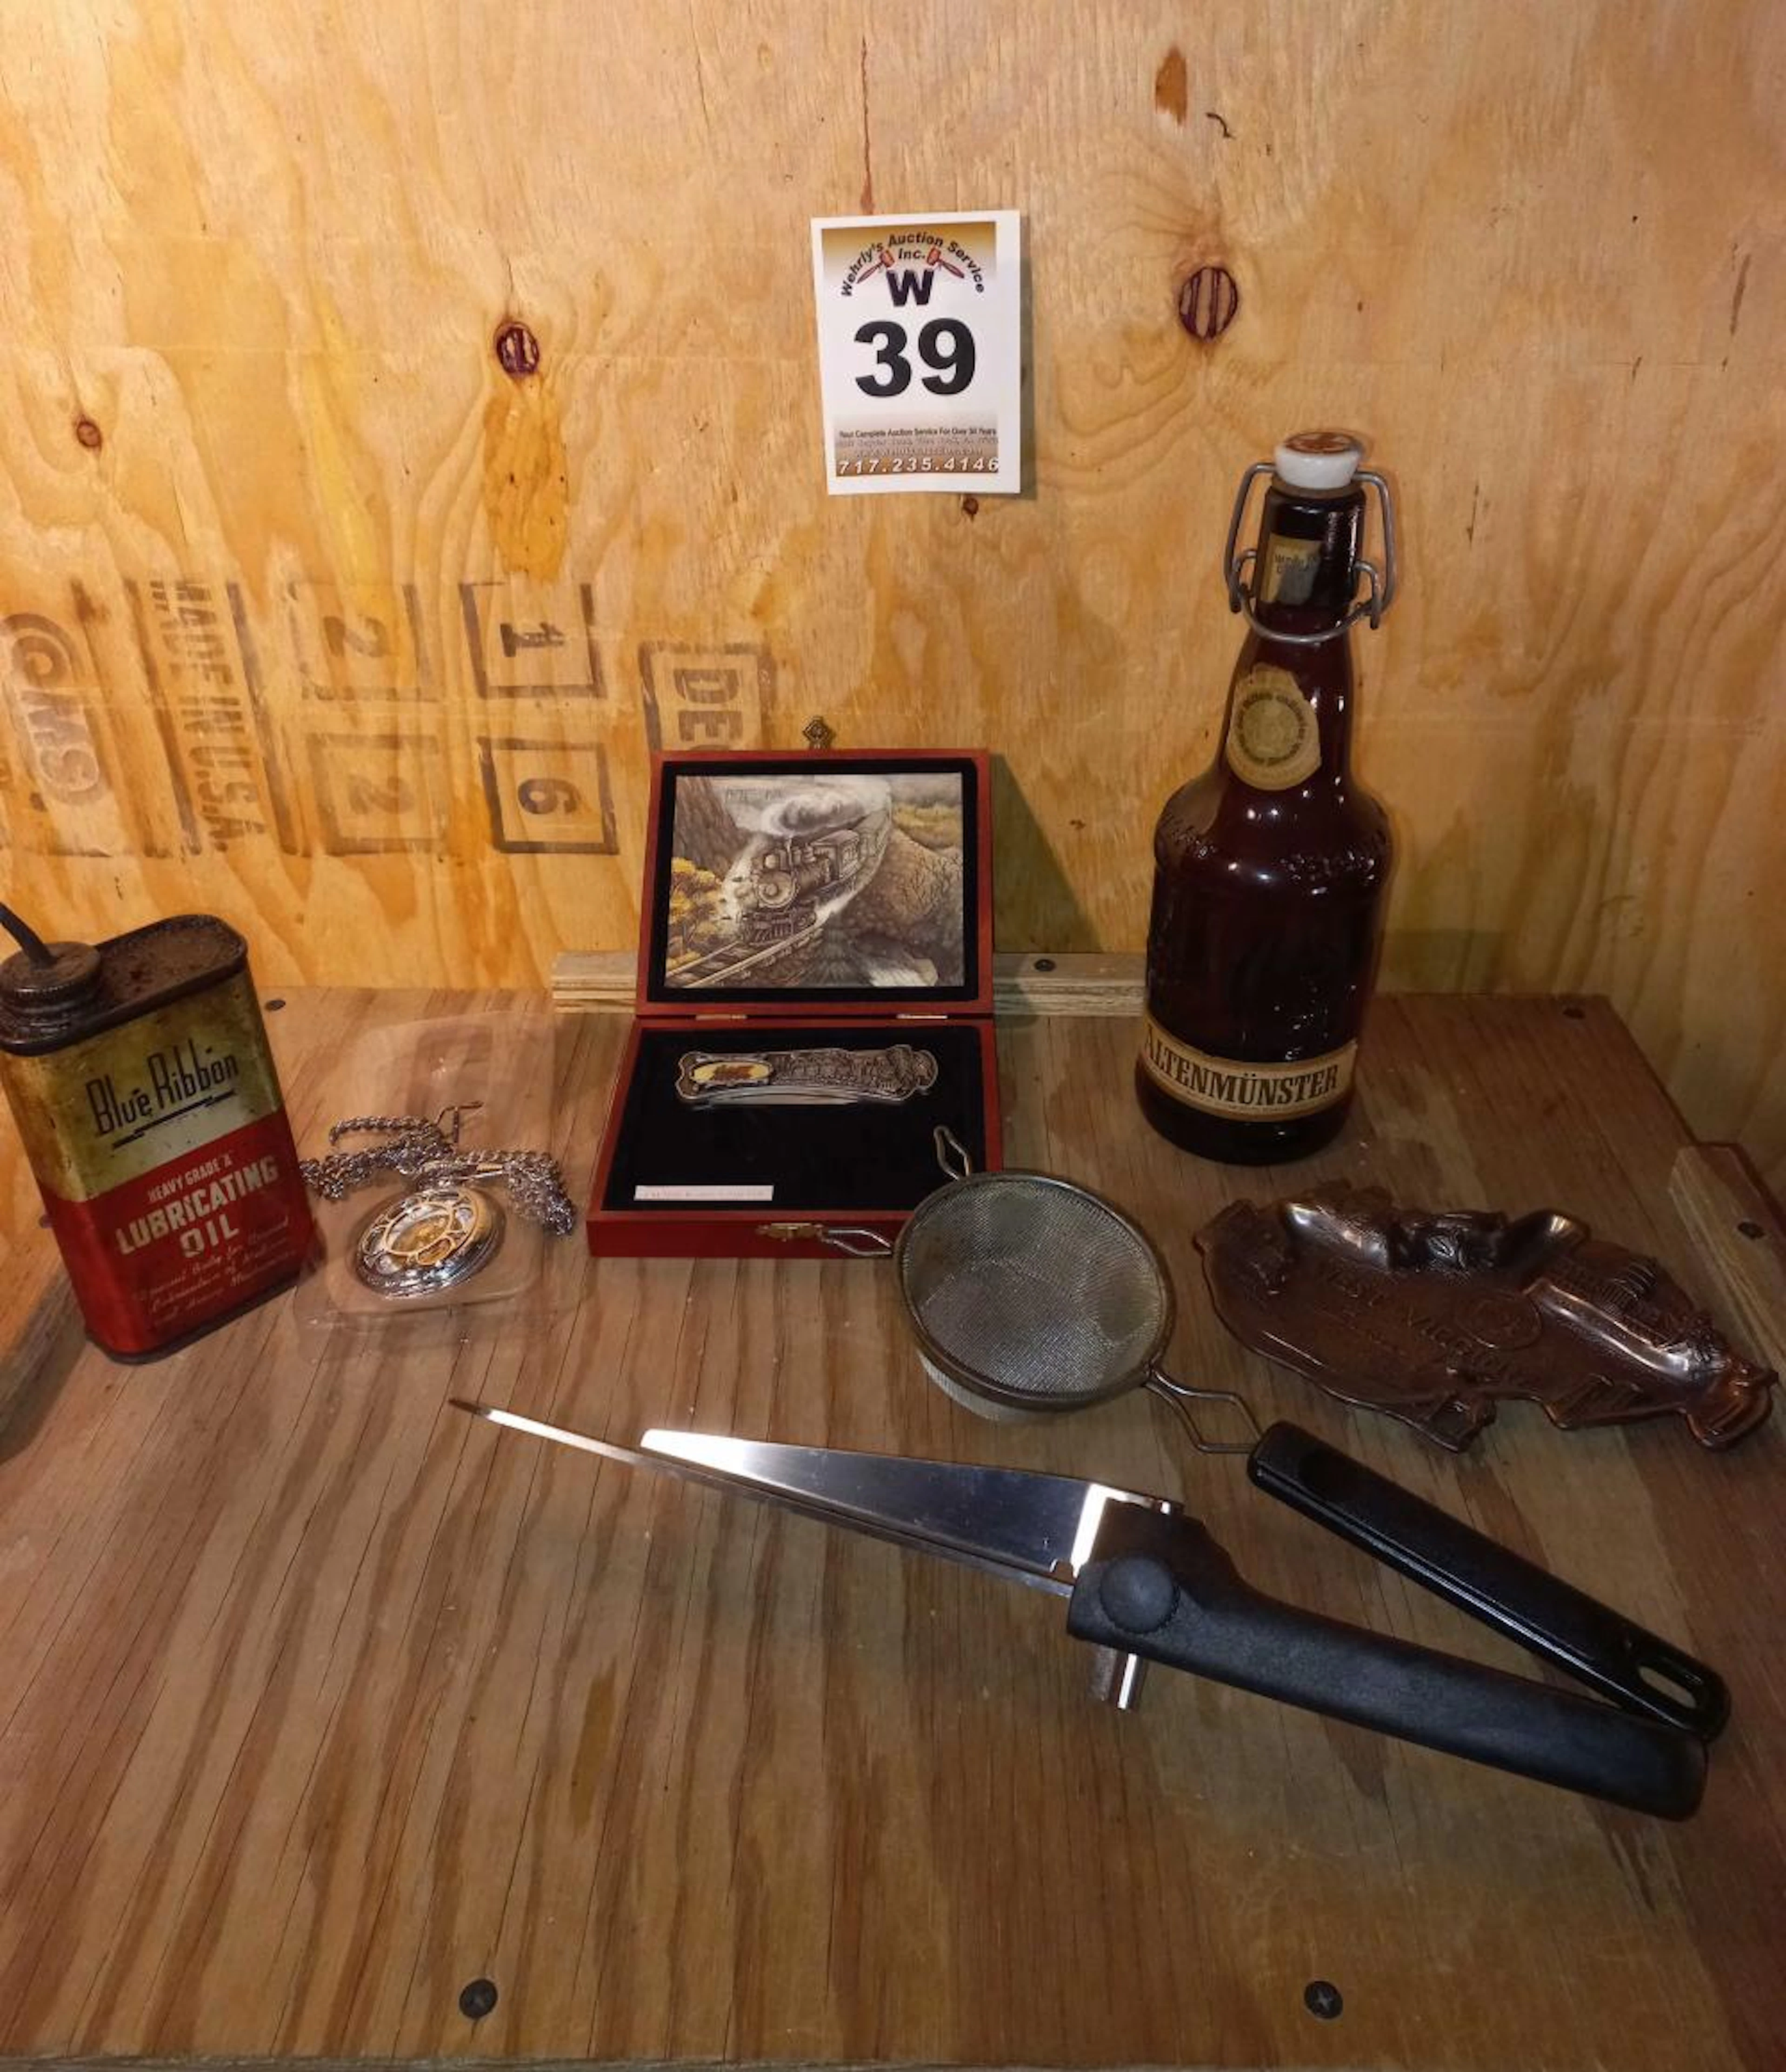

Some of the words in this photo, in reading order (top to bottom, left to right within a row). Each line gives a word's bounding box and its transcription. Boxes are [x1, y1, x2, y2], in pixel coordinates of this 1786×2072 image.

[841, 242, 884, 297] Wehrly's
[888, 232, 944, 247] Auction
[946, 240, 985, 294] Service
[898, 248, 926, 260] Inc.
[886, 269, 934, 307] W
[854, 318, 976, 397] 39
[888, 428, 913, 436] Auction
[839, 456, 1000, 475] 717.235.4146
[673, 668, 743, 750] DE
[517, 777, 581, 815] 6
[85, 1073, 153, 1135] Blue
[147, 1037, 239, 1110] Ribbon
[1145, 1026, 1339, 1105] ALTENMÜNSTER
[147, 1175, 184, 1203] HEAVY
[185, 1157, 221, 1185] GRADE
[116, 1155, 279, 1255] LUBRICATING
[180, 1213, 240, 1257] OIL
